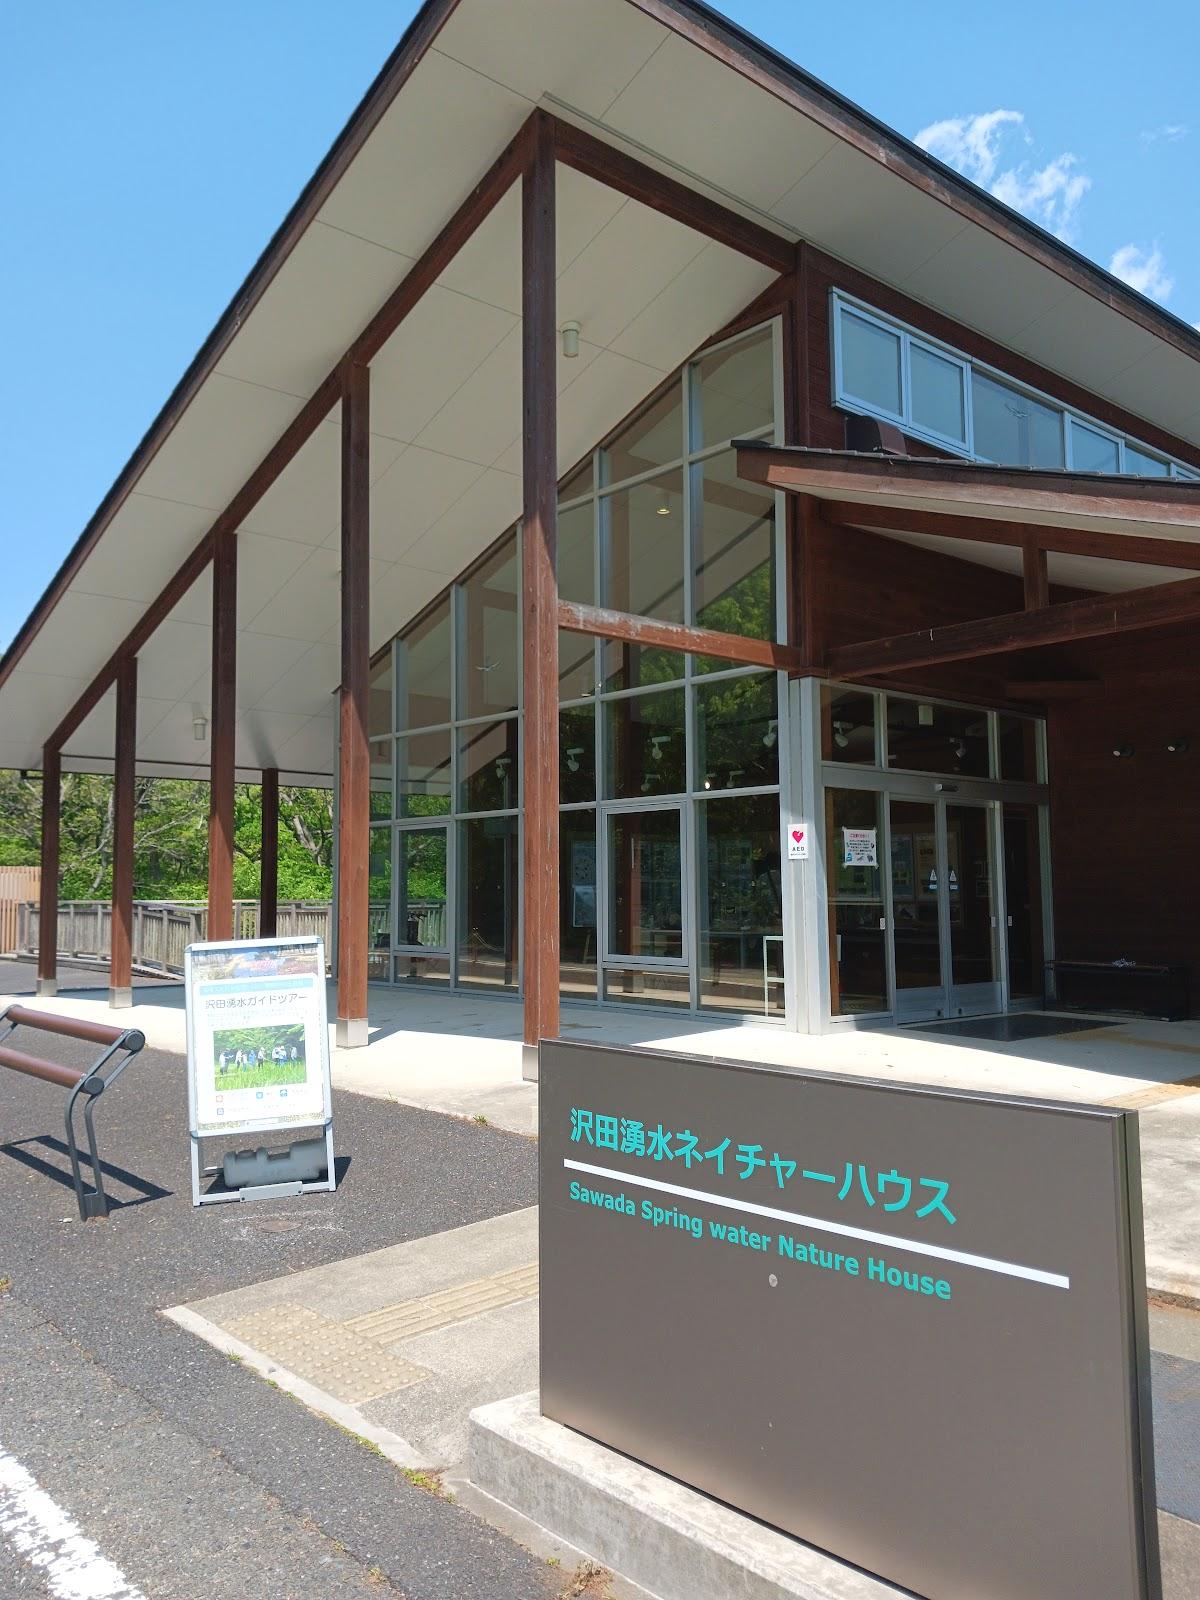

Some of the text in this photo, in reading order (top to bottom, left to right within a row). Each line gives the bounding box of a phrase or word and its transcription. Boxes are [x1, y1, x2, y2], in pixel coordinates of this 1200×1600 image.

[205, 993, 308, 1009] 沢田湧水ガイドツアー
[569, 1107, 957, 1225] 沢田湧水ネイチャーハウス
[569, 1181, 952, 1301] Sawada Spring water Nature House
